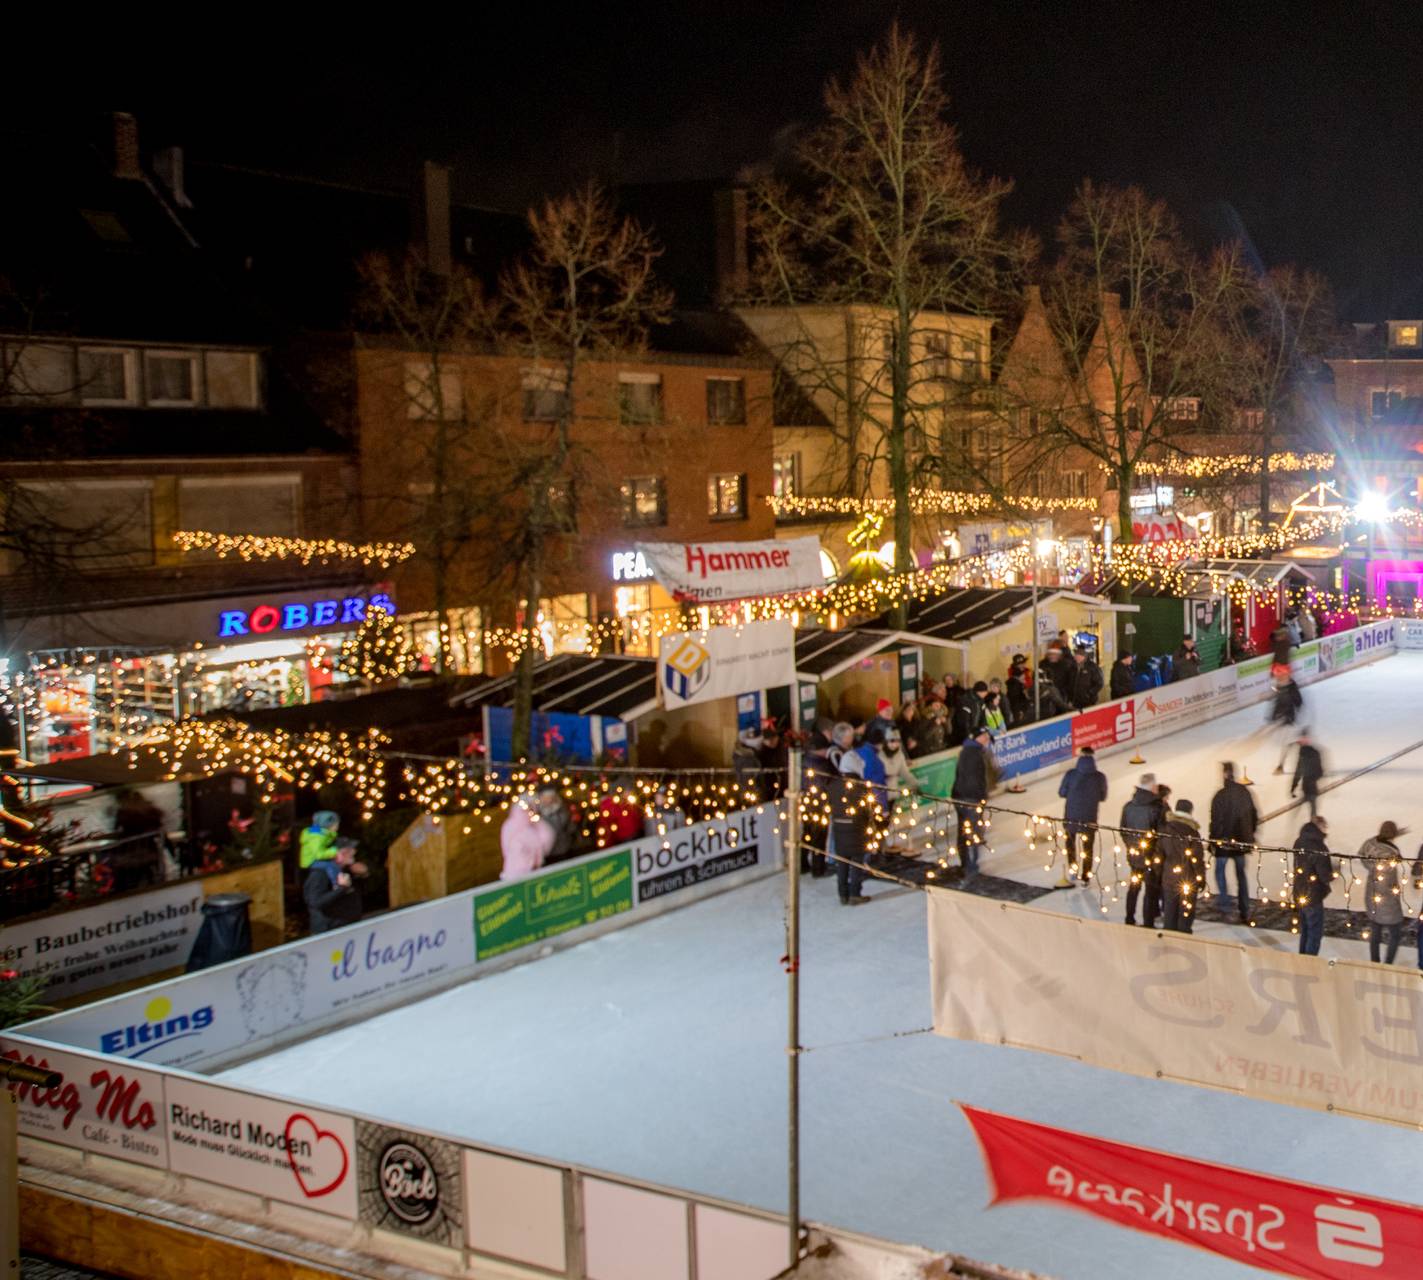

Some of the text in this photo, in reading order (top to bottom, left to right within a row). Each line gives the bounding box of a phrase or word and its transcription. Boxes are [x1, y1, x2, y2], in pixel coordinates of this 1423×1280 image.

[685, 546, 790, 579] Hammer
[218, 593, 396, 638] ROBERS
[1354, 625, 1395, 652] ahlert
[996, 735, 1060, 767] estmünsterland
[636, 815, 759, 876] bockholt
[641, 871, 683, 897] uhren
[697, 851, 756, 882] schmuck
[34, 896, 200, 954] Baubetriebshof
[104, 926, 189, 956] Weihnachten
[331, 939, 358, 982] il
[366, 927, 448, 973] bagno
[100, 1003, 215, 1055] Elting
[90, 1069, 157, 1130] Mo
[82, 1123, 110, 1145] Café
[121, 1133, 159, 1156] Bistro
[171, 1103, 312, 1158] Richard Moden
[173, 1130, 197, 1147] Mode
[200, 1139, 225, 1153] muss
[226, 1143, 272, 1165] Glücklich
